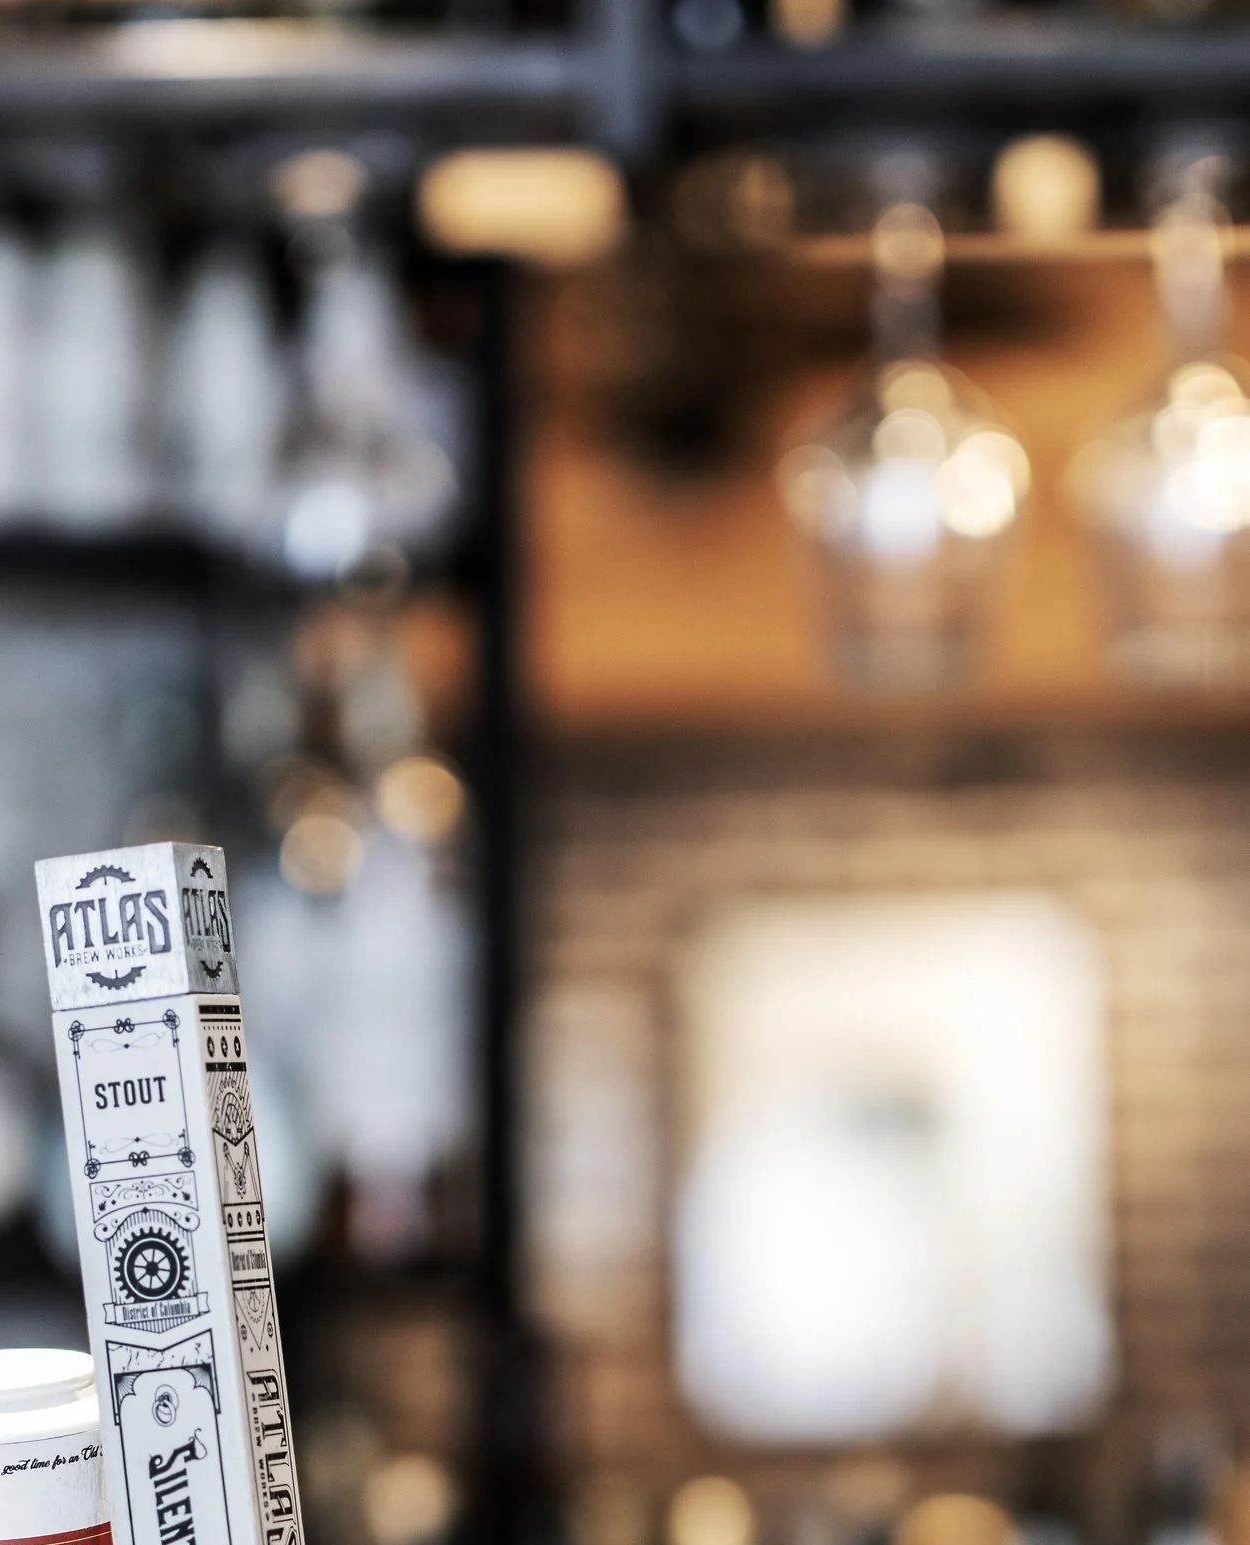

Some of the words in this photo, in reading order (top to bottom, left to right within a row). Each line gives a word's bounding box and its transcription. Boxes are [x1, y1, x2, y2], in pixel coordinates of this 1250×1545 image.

[50, 889, 173, 968] ATLAS
[182, 888, 231, 953] ATLAS
[68, 950, 100, 966] BREW
[105, 945, 145, 961] WORKS
[94, 1076, 166, 1110] STOUT
[122, 1304, 150, 1321] District
[151, 1303, 159, 1314] of
[159, 1301, 191, 1317] Columbia
[252, 1406, 263, 1449] BREW
[0, 1459, 30, 1476] good
[30, 1458, 50, 1470] time
[51, 1454, 67, 1470] for
[68, 1454, 79, 1463] an
